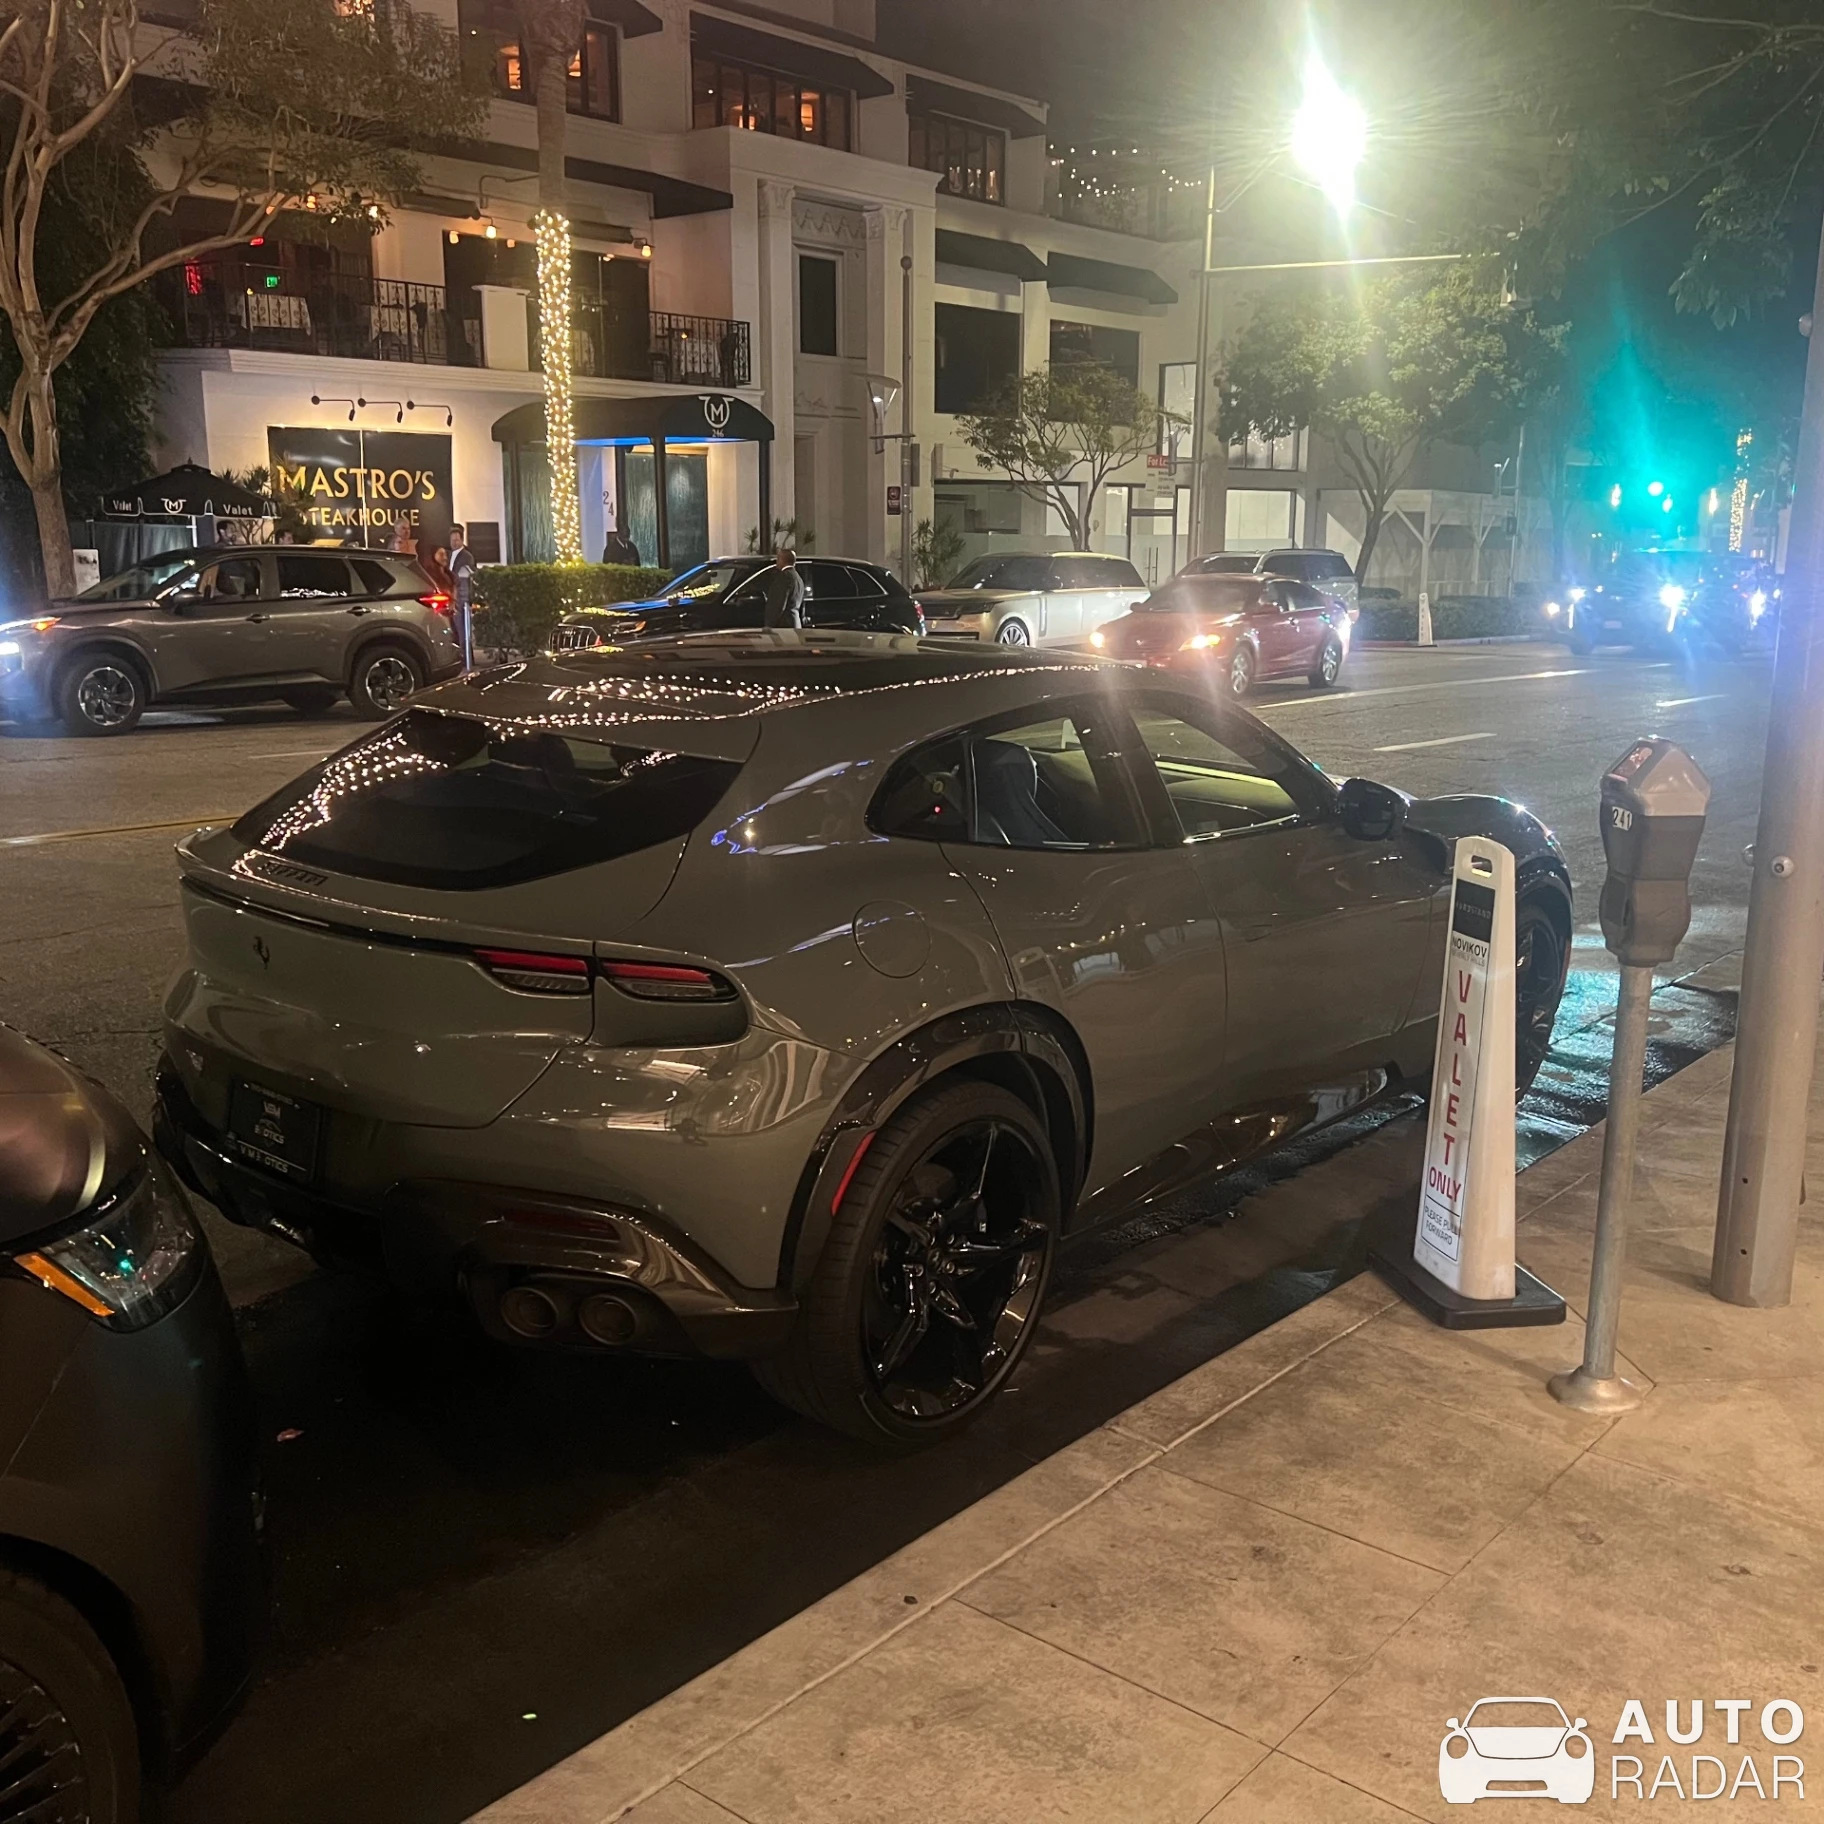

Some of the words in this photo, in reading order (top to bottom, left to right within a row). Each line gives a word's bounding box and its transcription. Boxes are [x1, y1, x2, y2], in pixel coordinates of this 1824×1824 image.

[276, 465, 436, 500] MASTRO'S
[113, 500, 132, 511] Valet
[223, 504, 253, 516] Valet
[1612, 808, 1631, 829] 241
[1452, 935, 1488, 958] NOVIKOV
[1442, 969, 1471, 1166] VALET
[1429, 1166, 1461, 1202] ONLY
[1424, 1205, 1443, 1226] PLEASE
[1425, 1219, 1453, 1246] FORWARD
